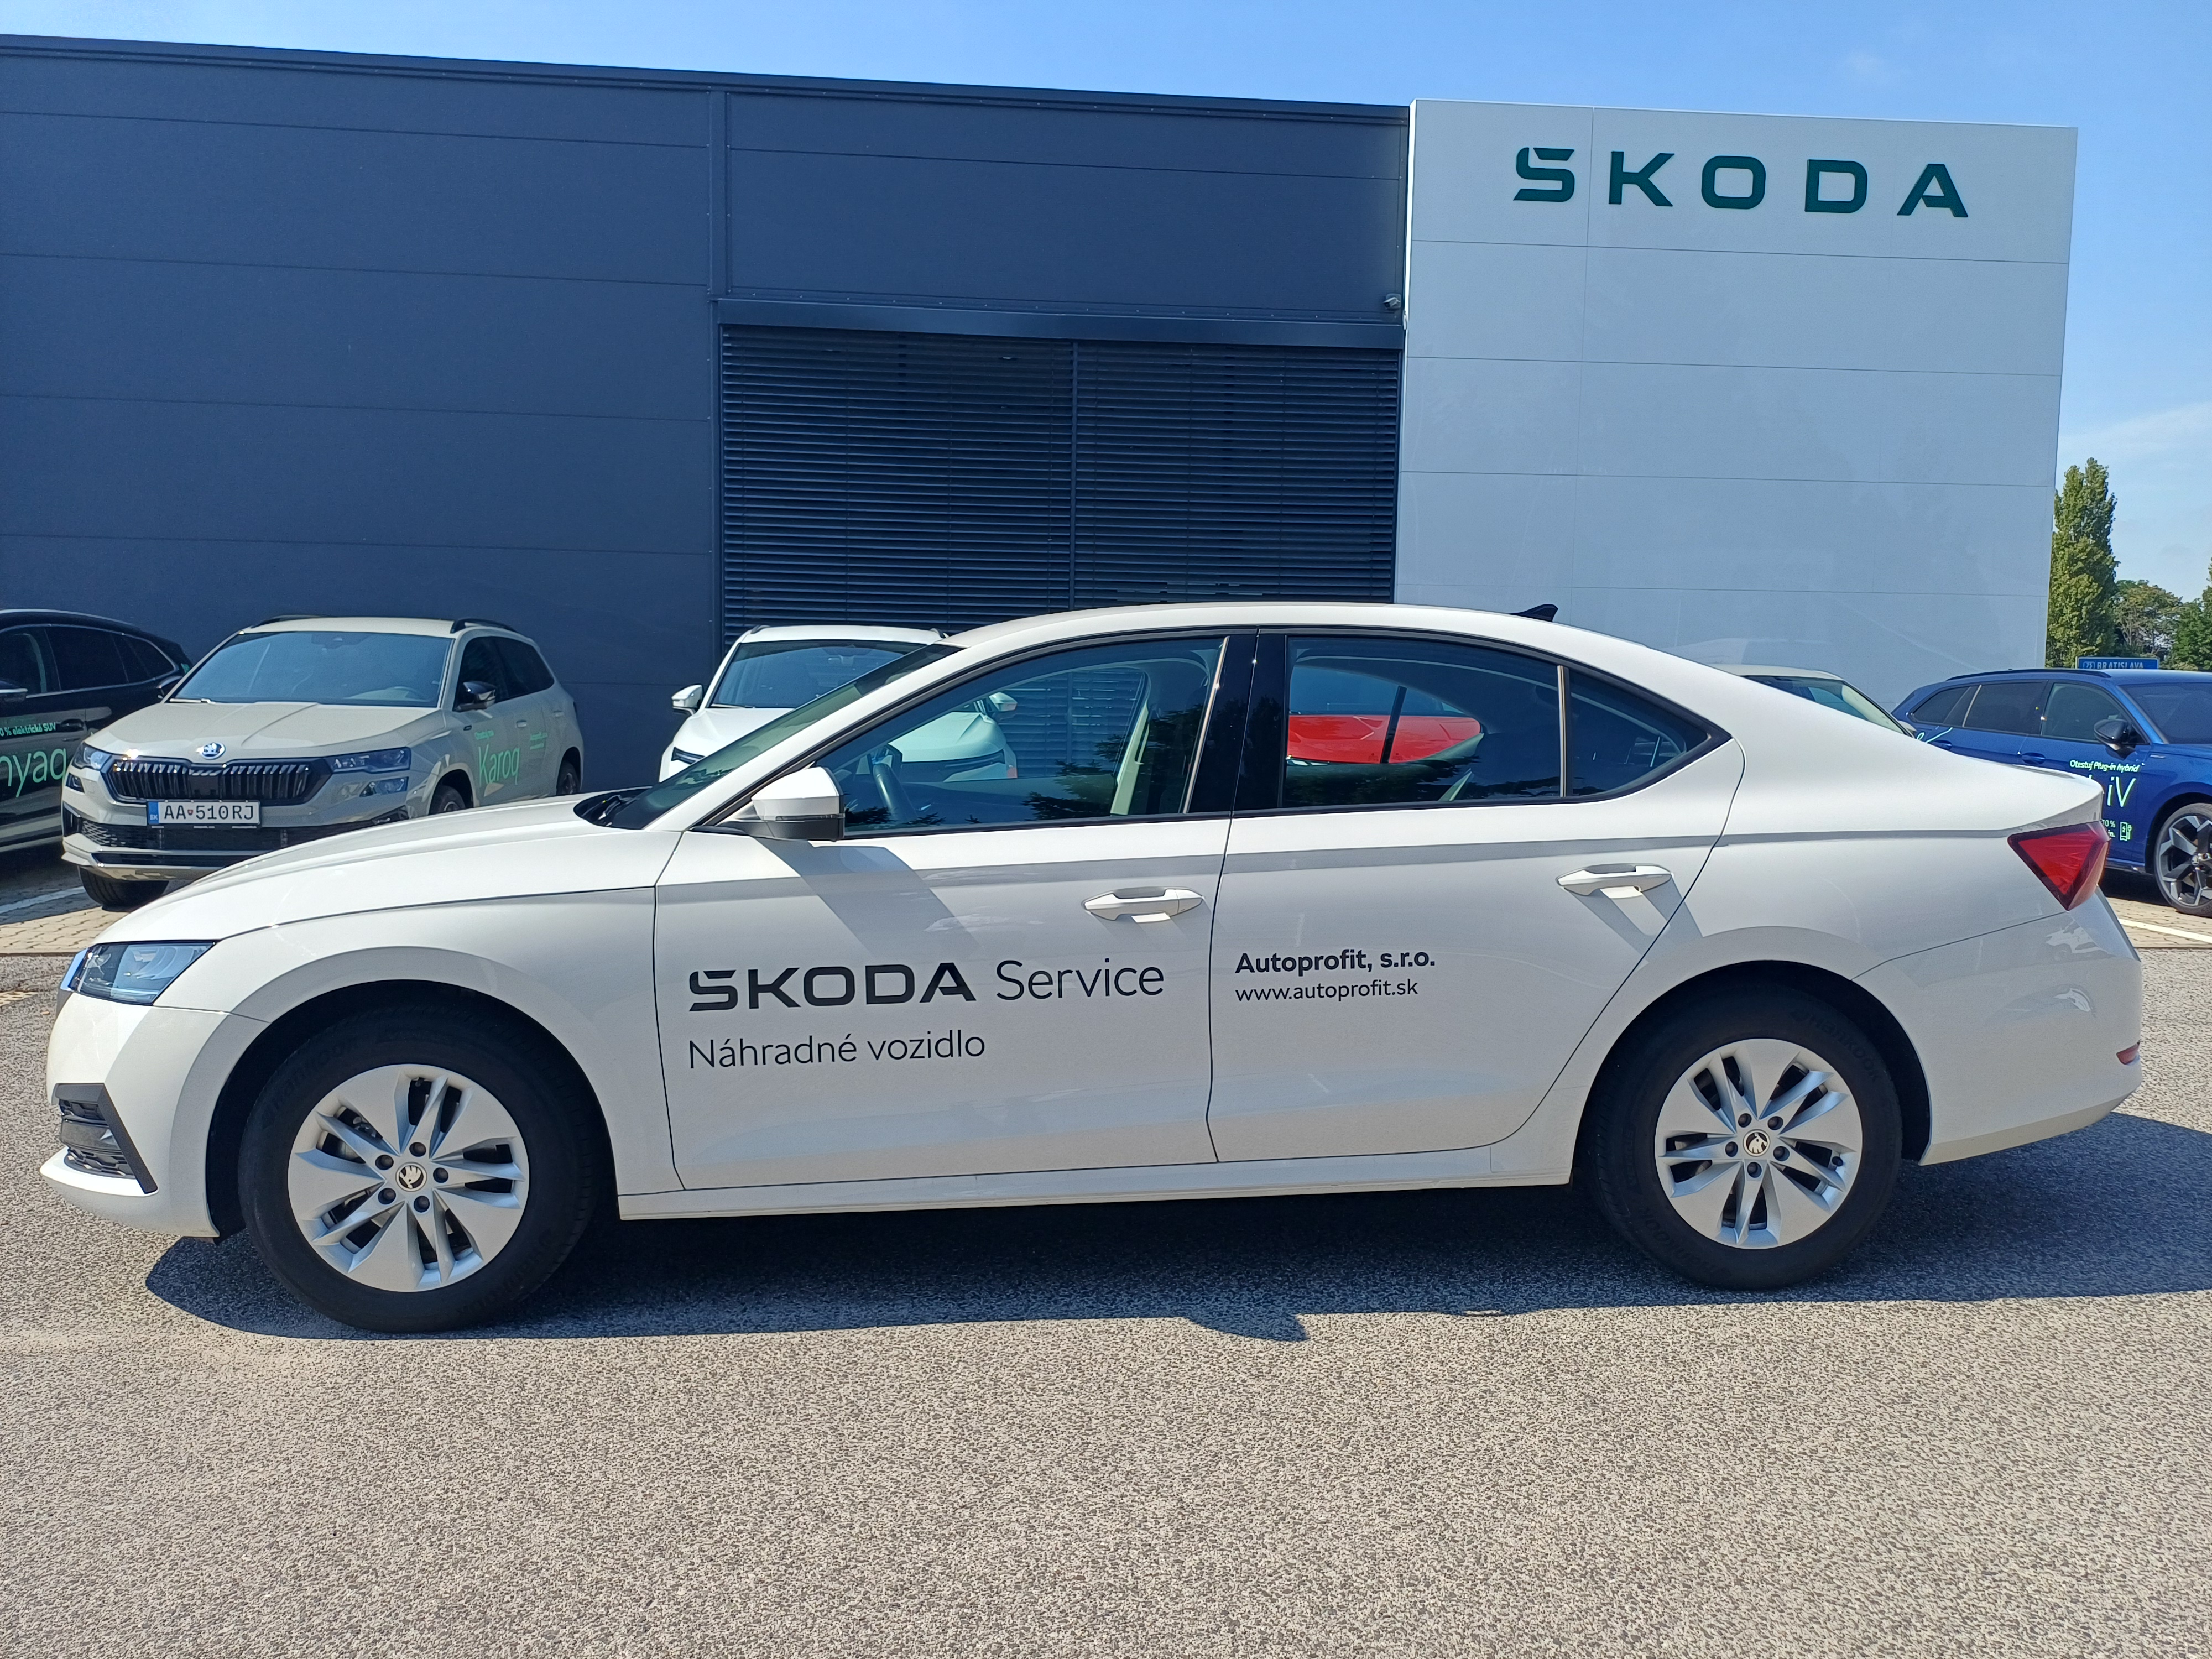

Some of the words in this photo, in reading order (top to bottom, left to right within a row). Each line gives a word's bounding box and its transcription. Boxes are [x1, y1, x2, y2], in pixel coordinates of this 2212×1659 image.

[43, 722, 56, 732] SUV
[478, 744, 520, 787] Karoq
[2070, 760, 2094, 771] Otestuj
[2094, 762, 2116, 771] Plug-in
[2117, 764, 2141, 774] hybrid
[2107, 777, 2136, 807] iV
[164, 805, 186, 820] AA
[1235, 949, 1373, 977] Autoprofit,
[1380, 951, 1435, 968] s.r.o.
[997, 958, 1164, 1000] Service
[1235, 978, 1418, 1002] www.autoprofit.sk
[690, 1033, 857, 1068] Náhradné
[867, 1029, 985, 1060] vozidlo
